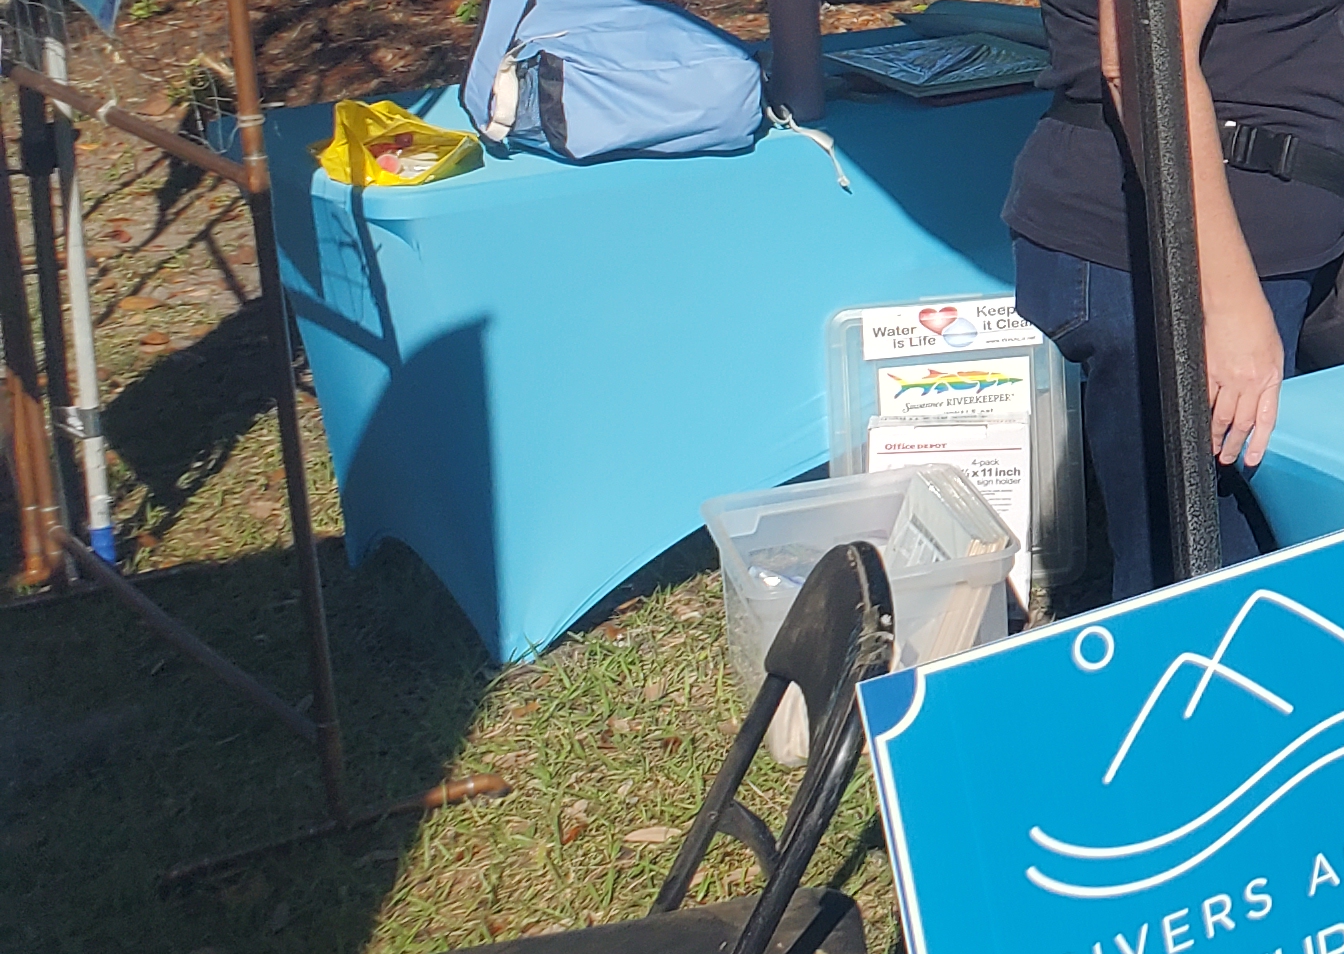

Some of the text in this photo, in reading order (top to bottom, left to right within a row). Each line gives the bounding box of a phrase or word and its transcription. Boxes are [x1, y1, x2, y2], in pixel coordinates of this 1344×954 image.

[976, 305, 1016, 318] Keep
[983, 319, 993, 331] it
[872, 325, 918, 338] Water
[893, 335, 937, 349] is Life
[884, 442, 916, 451] Office
[971, 470, 980, 478] x
[981, 467, 993, 477] 11
[994, 466, 1022, 477] inch
[977, 479, 994, 487] sign
